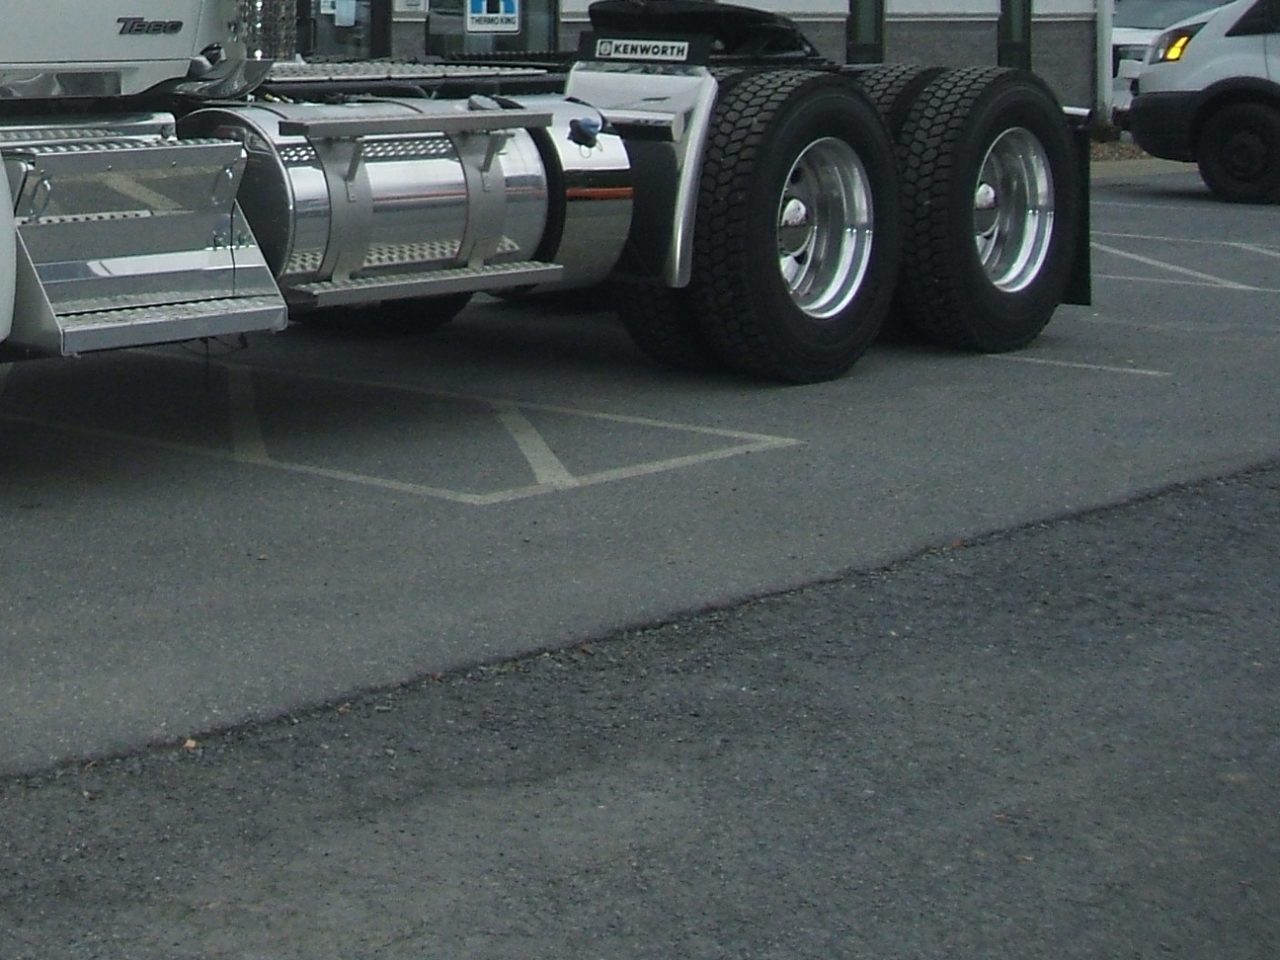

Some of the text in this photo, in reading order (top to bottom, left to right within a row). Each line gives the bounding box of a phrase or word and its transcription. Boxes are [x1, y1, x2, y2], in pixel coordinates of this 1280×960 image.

[116, 16, 184, 35] T880
[470, 16, 516, 25] THERMO KING
[613, 43, 686, 57] KENWORTH
